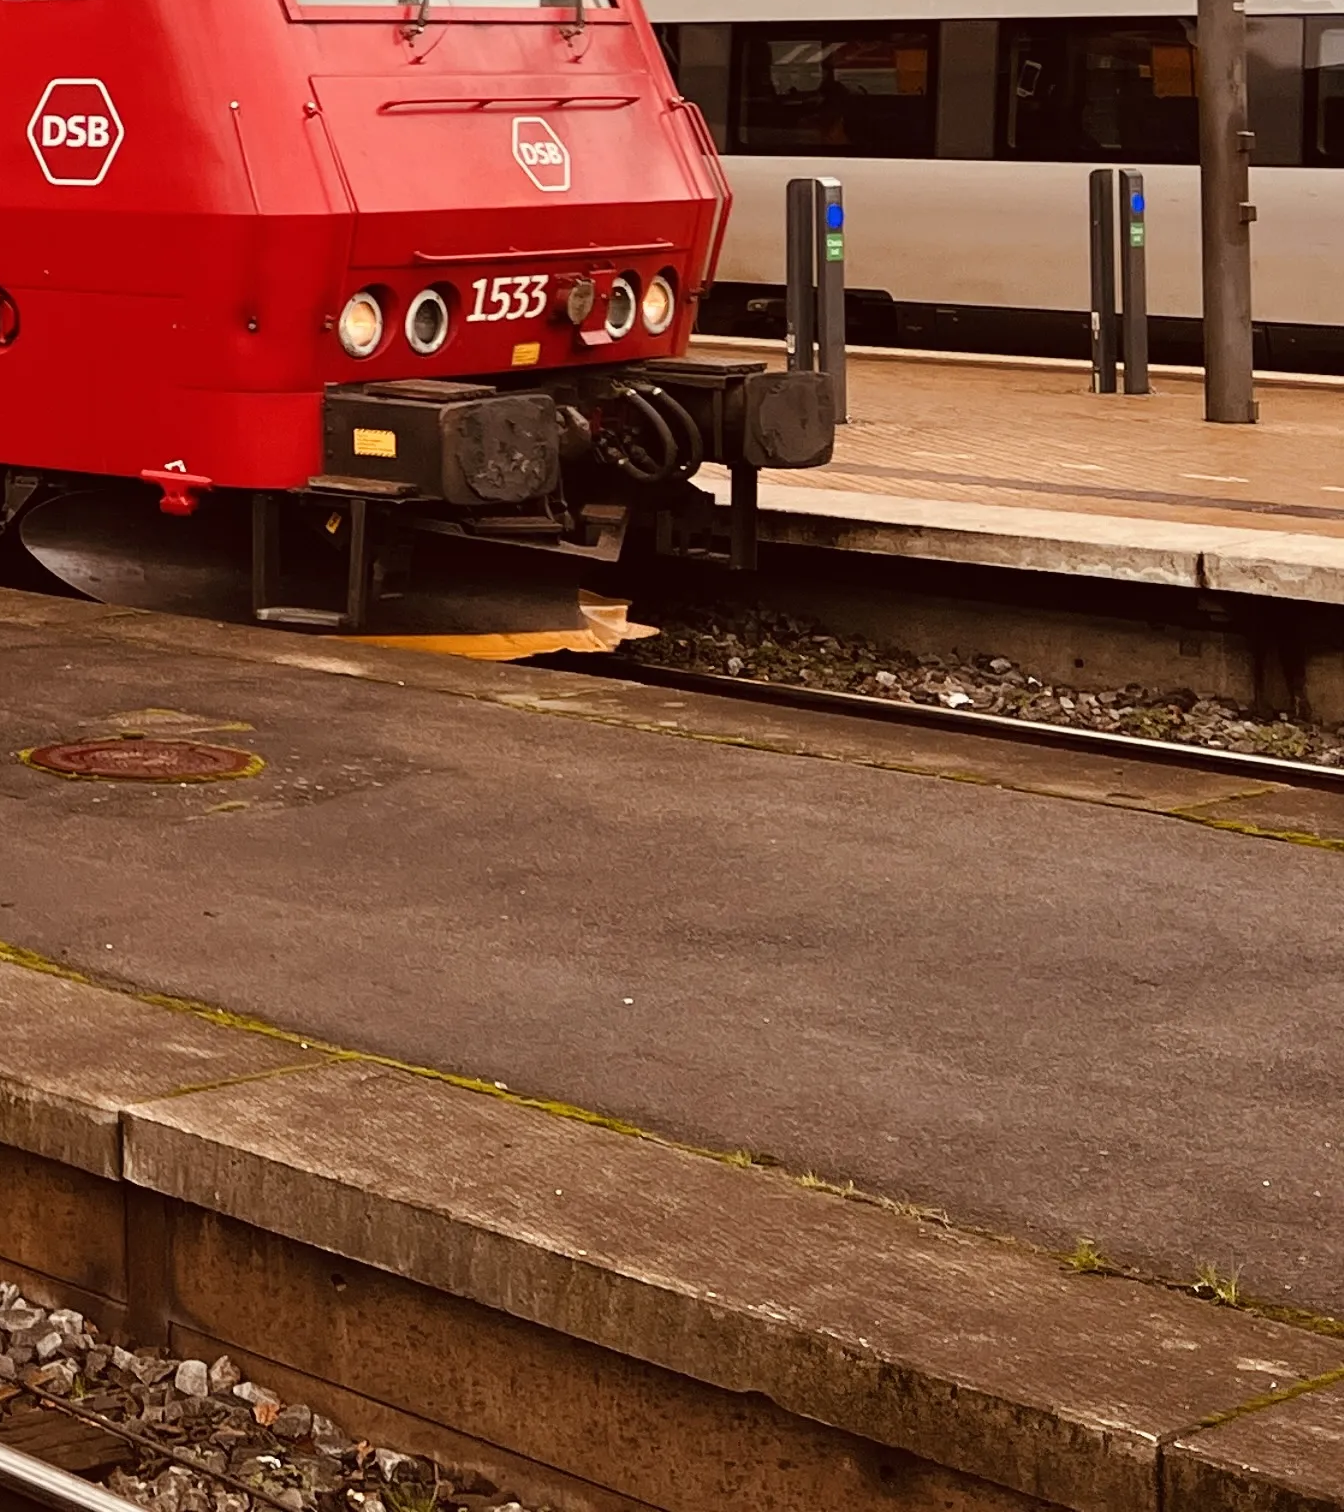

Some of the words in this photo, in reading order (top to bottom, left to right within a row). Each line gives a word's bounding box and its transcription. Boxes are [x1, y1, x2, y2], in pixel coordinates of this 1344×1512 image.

[42, 115, 109, 147] DSB
[519, 142, 563, 166] DSB
[466, 274, 549, 323] 1533
